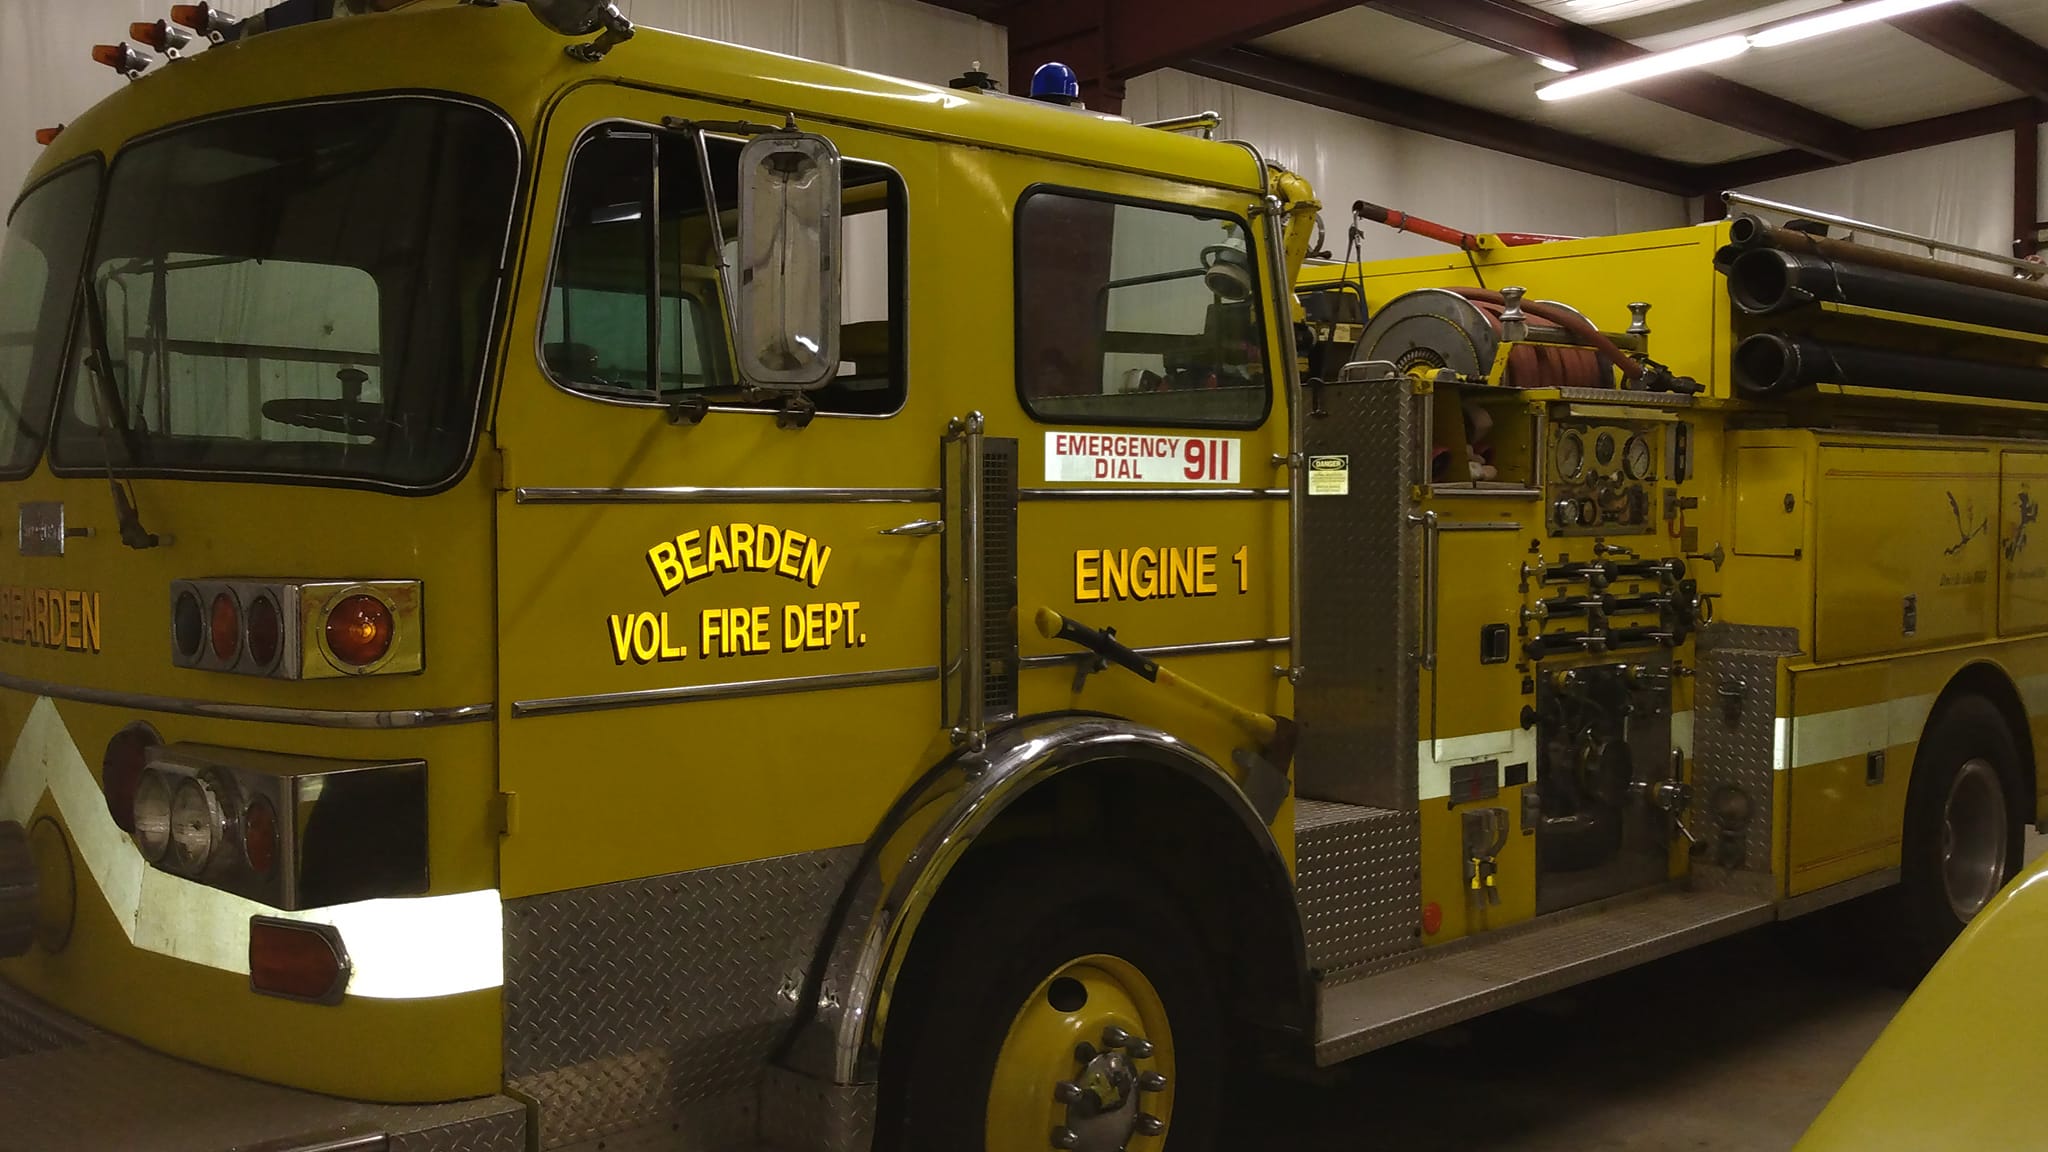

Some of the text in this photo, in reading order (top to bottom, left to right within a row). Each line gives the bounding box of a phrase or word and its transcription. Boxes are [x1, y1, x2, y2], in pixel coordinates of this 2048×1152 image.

[1056, 435, 1229, 480] EMERGENCY 911
[1095, 458, 1142, 479] DIAL
[1315, 460, 1342, 468] DANGER
[646, 523, 833, 597] BEARDEN
[1073, 544, 1249, 603] ENGINE 1
[0, 586, 101, 653] BEARDEN
[607, 600, 867, 666] VOL. FIRE DEPT.
